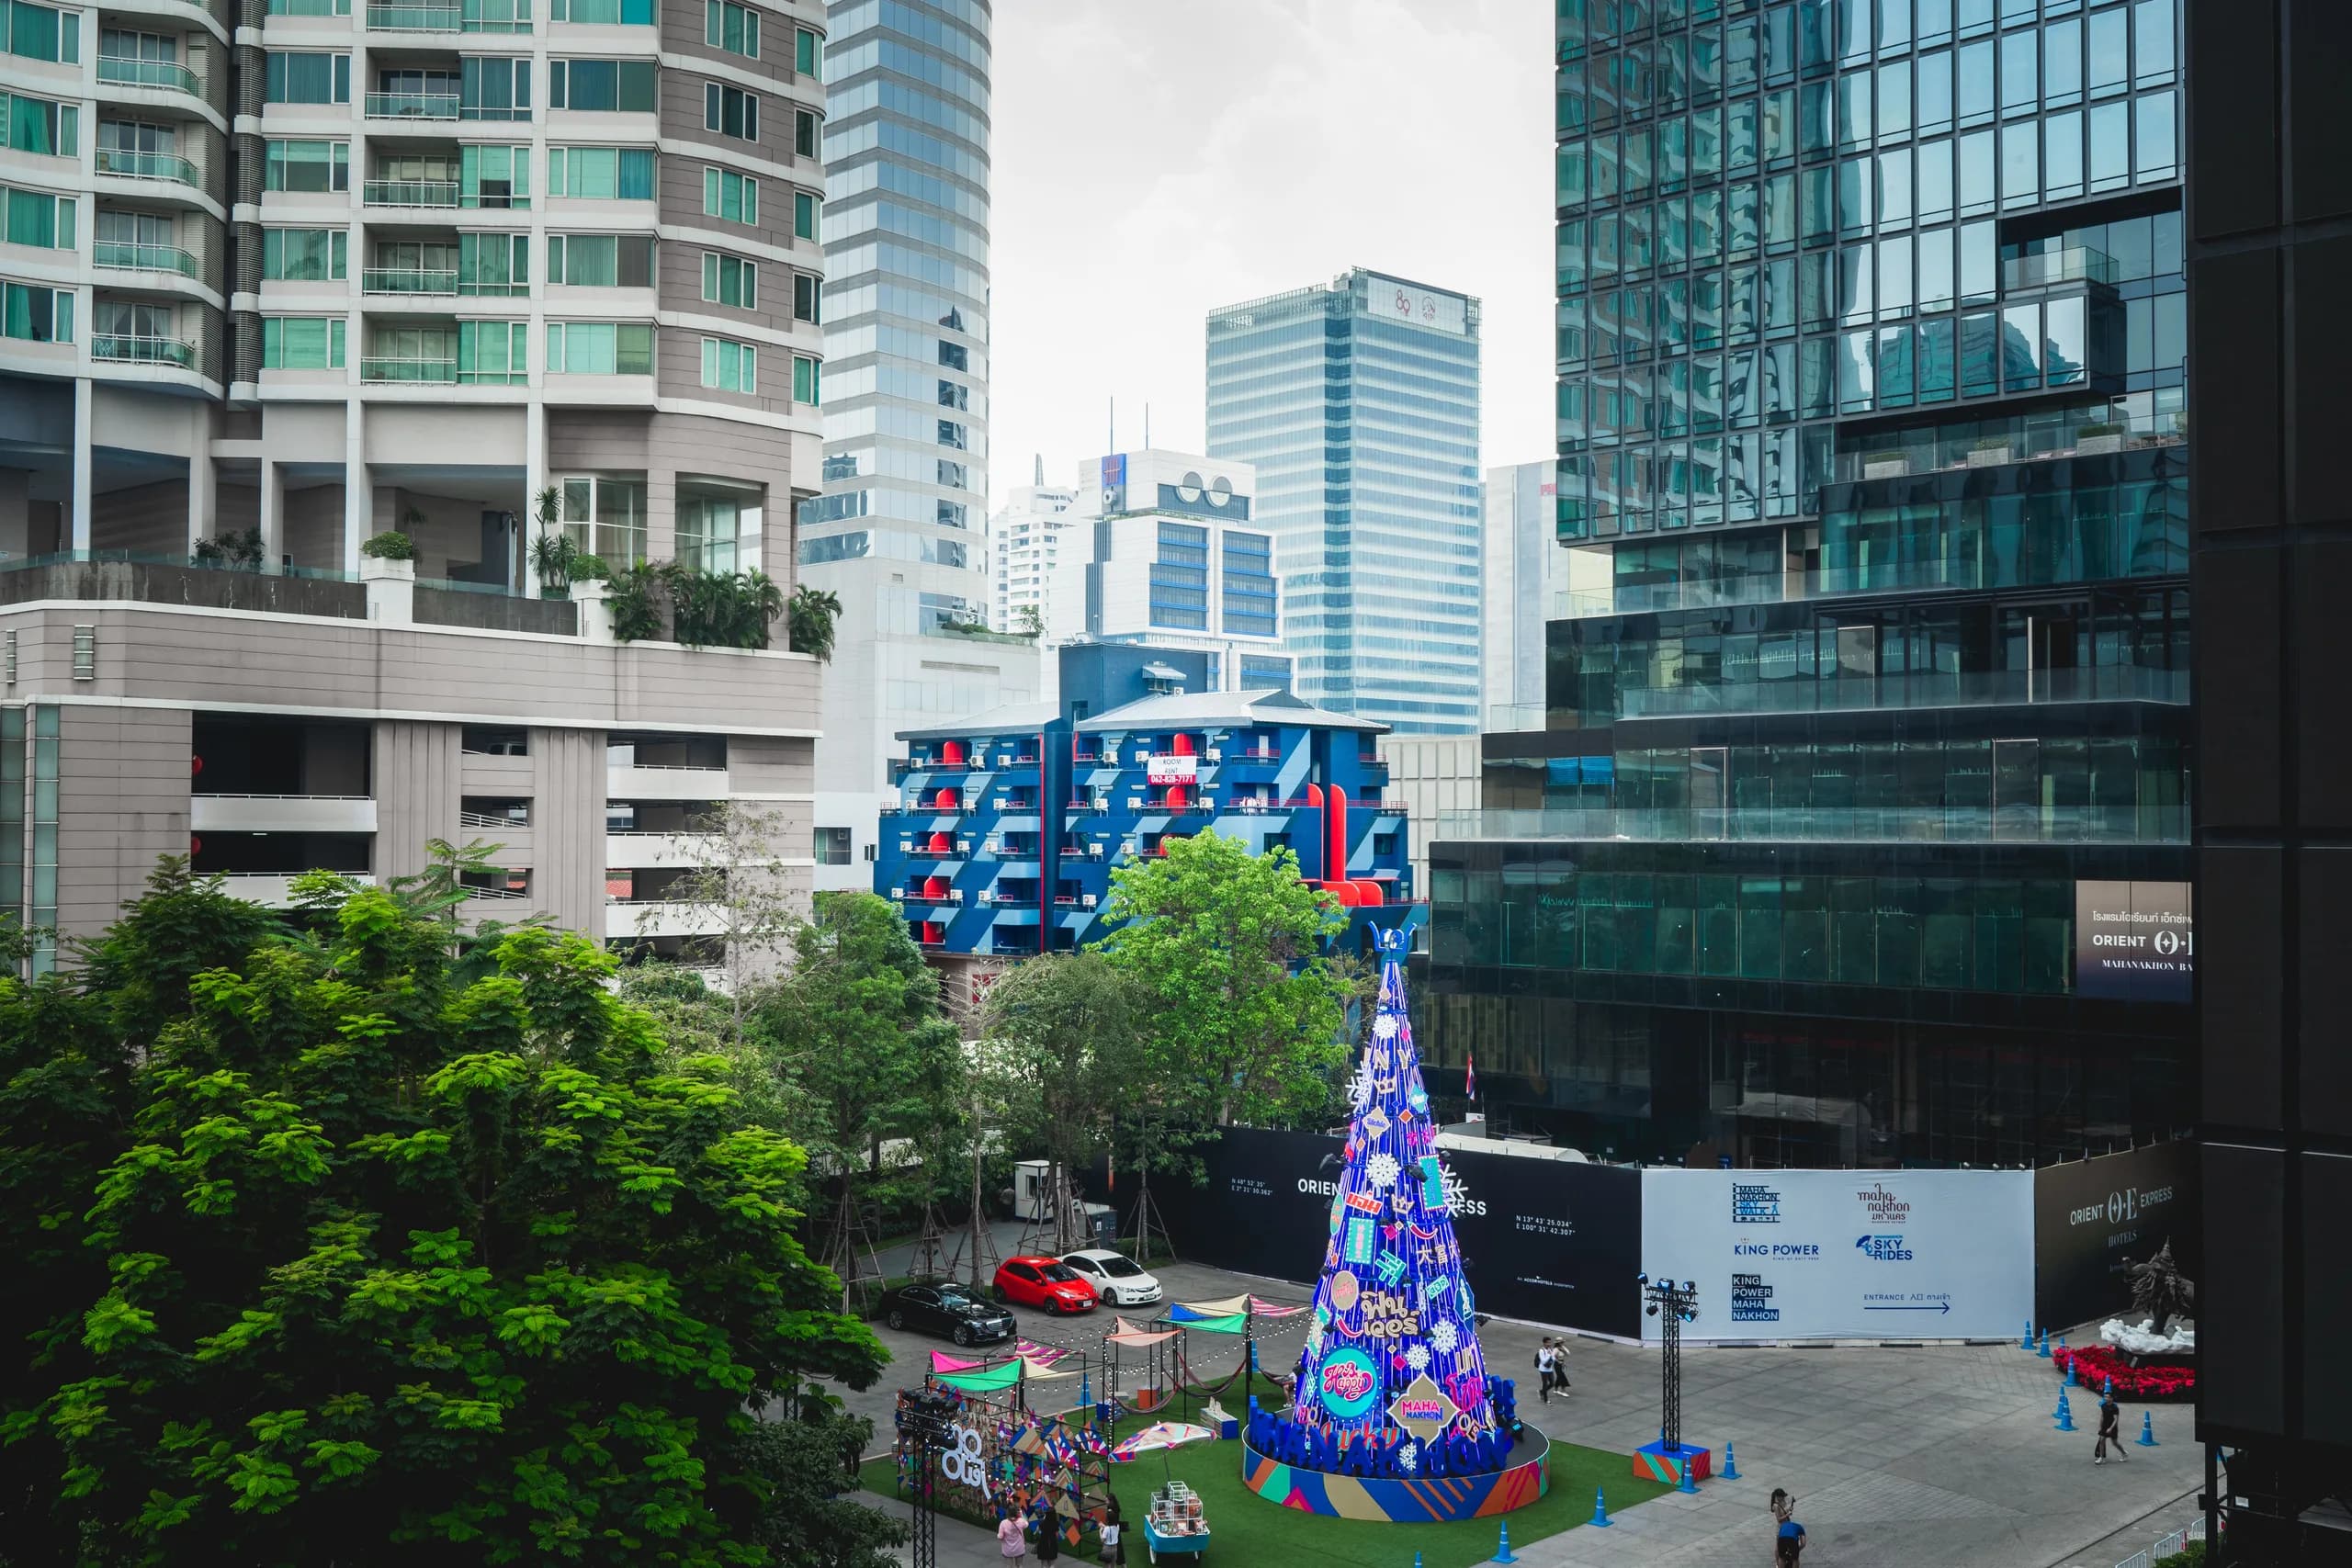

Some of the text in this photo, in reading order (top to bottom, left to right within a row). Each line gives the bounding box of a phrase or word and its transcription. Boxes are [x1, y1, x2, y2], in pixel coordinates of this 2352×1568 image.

[2093, 934, 2146, 947] ORIENT
[2102, 959, 2175, 971] MAHANAKHON
[1297, 1179, 1340, 1195] ORIEN
[2070, 1204, 2104, 1225] ORIENT
[2140, 1186, 2173, 1208] EXPRESS
[2108, 1230, 2138, 1247] HOTELS
[1735, 1245, 1819, 1255] KING POWER
[1874, 1239, 1903, 1250] SKY
[1874, 1249, 1913, 1260] RIDES
[1733, 1277, 1759, 1285] KING
[1733, 1288, 1771, 1297] POWER
[1733, 1300, 1764, 1309] MAHA
[1733, 1312, 1778, 1320] NAKHON
[1401, 1400, 1440, 1417] MAHA
[1407, 1409, 1443, 1421] NAKHON
